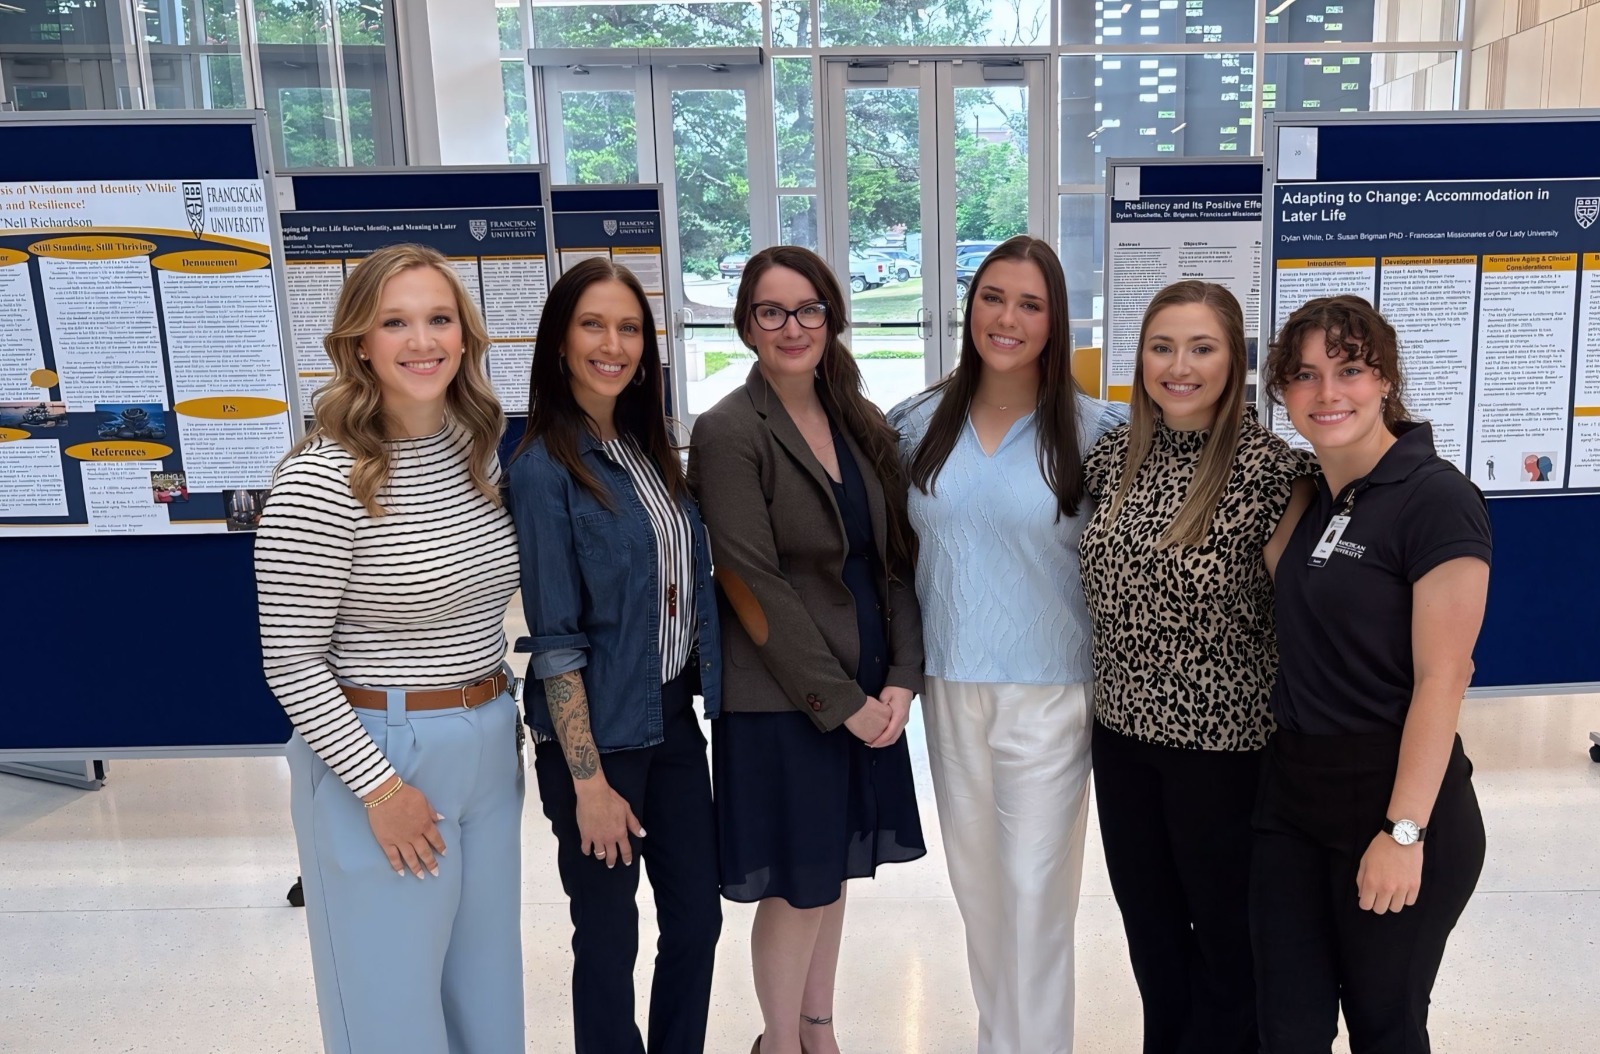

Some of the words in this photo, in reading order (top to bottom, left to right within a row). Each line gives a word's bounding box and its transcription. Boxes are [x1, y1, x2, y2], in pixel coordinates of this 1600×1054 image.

[16, 185, 26, 195] of
[30, 185, 73, 194] Wisdom
[76, 184, 96, 194] and
[100, 184, 142, 196] Identity
[146, 183, 177, 193] While
[207, 187, 262, 203] FRANCISCAN
[1282, 192, 1344, 206] Adapting
[1349, 192, 1362, 203] to
[1366, 190, 1421, 205] Change:
[1425, 188, 1533, 202] Accommodation
[1538, 188, 1549, 200] in
[6, 201, 25, 210] and
[29, 200, 85, 210] Resilience!
[1125, 201, 1171, 211] Resiliency
[1173, 201, 1189, 209] and
[1192, 201, 1203, 209] Its
[1206, 201, 1241, 209] Positive
[1282, 210, 1317, 222] Later
[1322, 209, 1346, 221] Life
[31, 217, 93, 228] Richardson
[211, 217, 265, 232] UNIVERSITY
[1360, 233, 1387, 241] Brigman
[33, 244, 51, 252] Still
[53, 244, 94, 252] Standing,
[115, 243, 153, 251] Thriving
[182, 258, 238, 267] Denouement
[1385, 258, 1432, 266] Developmental
[1433, 257, 1474, 265] Interpretation
[91, 447, 146, 456] References
